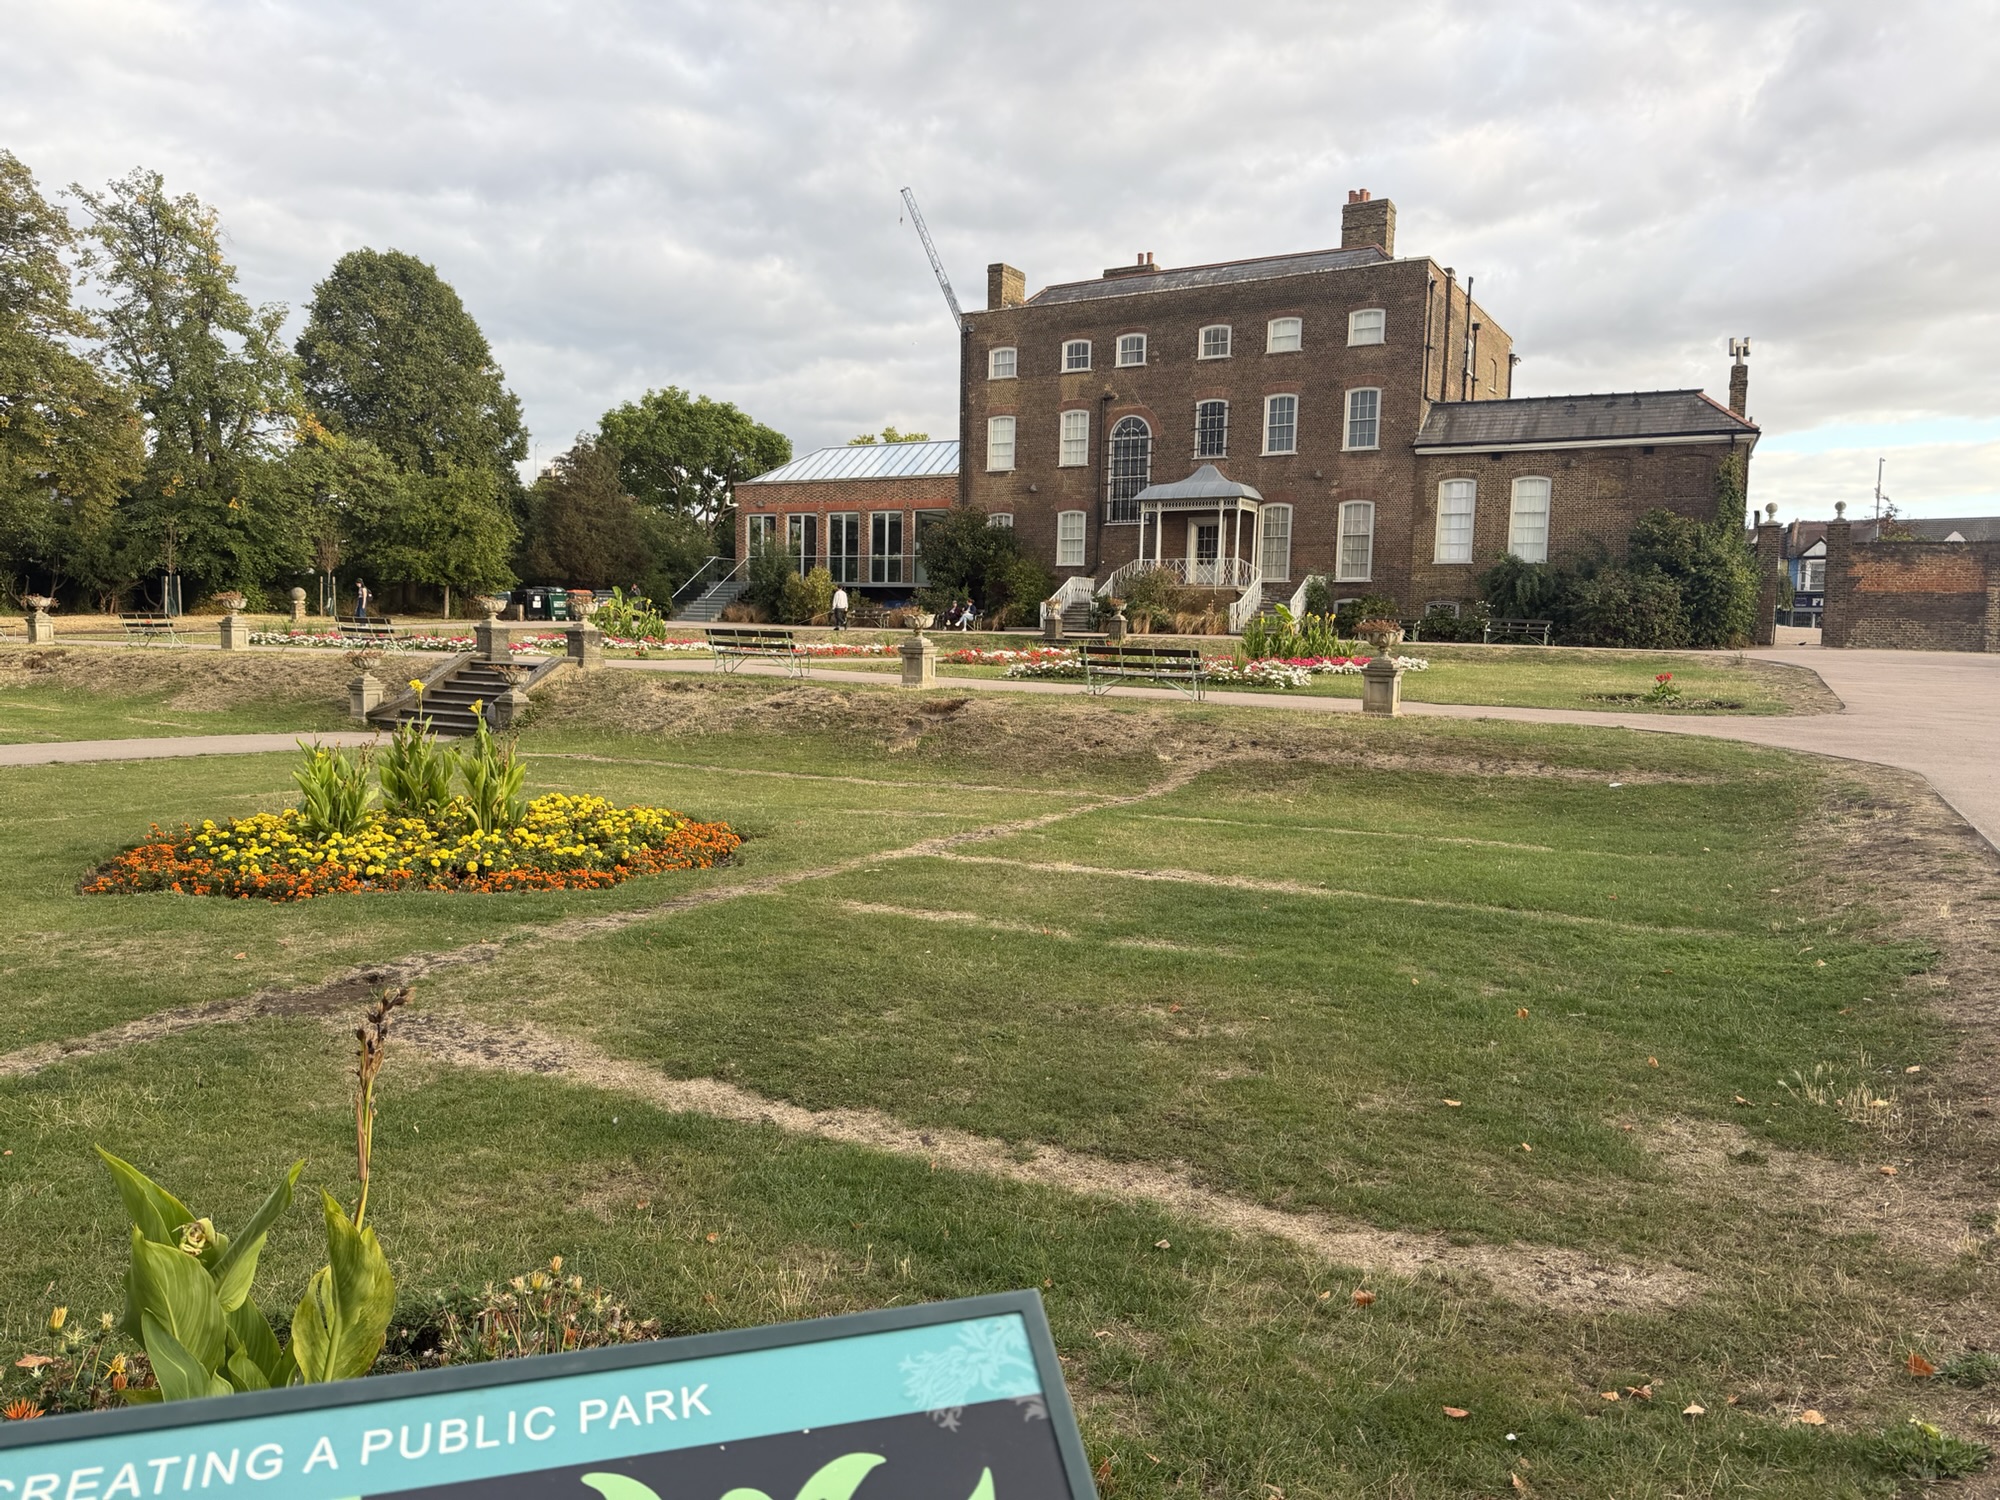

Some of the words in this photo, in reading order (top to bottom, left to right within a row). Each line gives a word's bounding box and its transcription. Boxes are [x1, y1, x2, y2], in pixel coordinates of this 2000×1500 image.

[0, 1443, 284, 1500] REATING
[303, 1436, 339, 1474] A
[361, 1406, 556, 1465] PUBLIC
[579, 1384, 712, 1434] PARK
